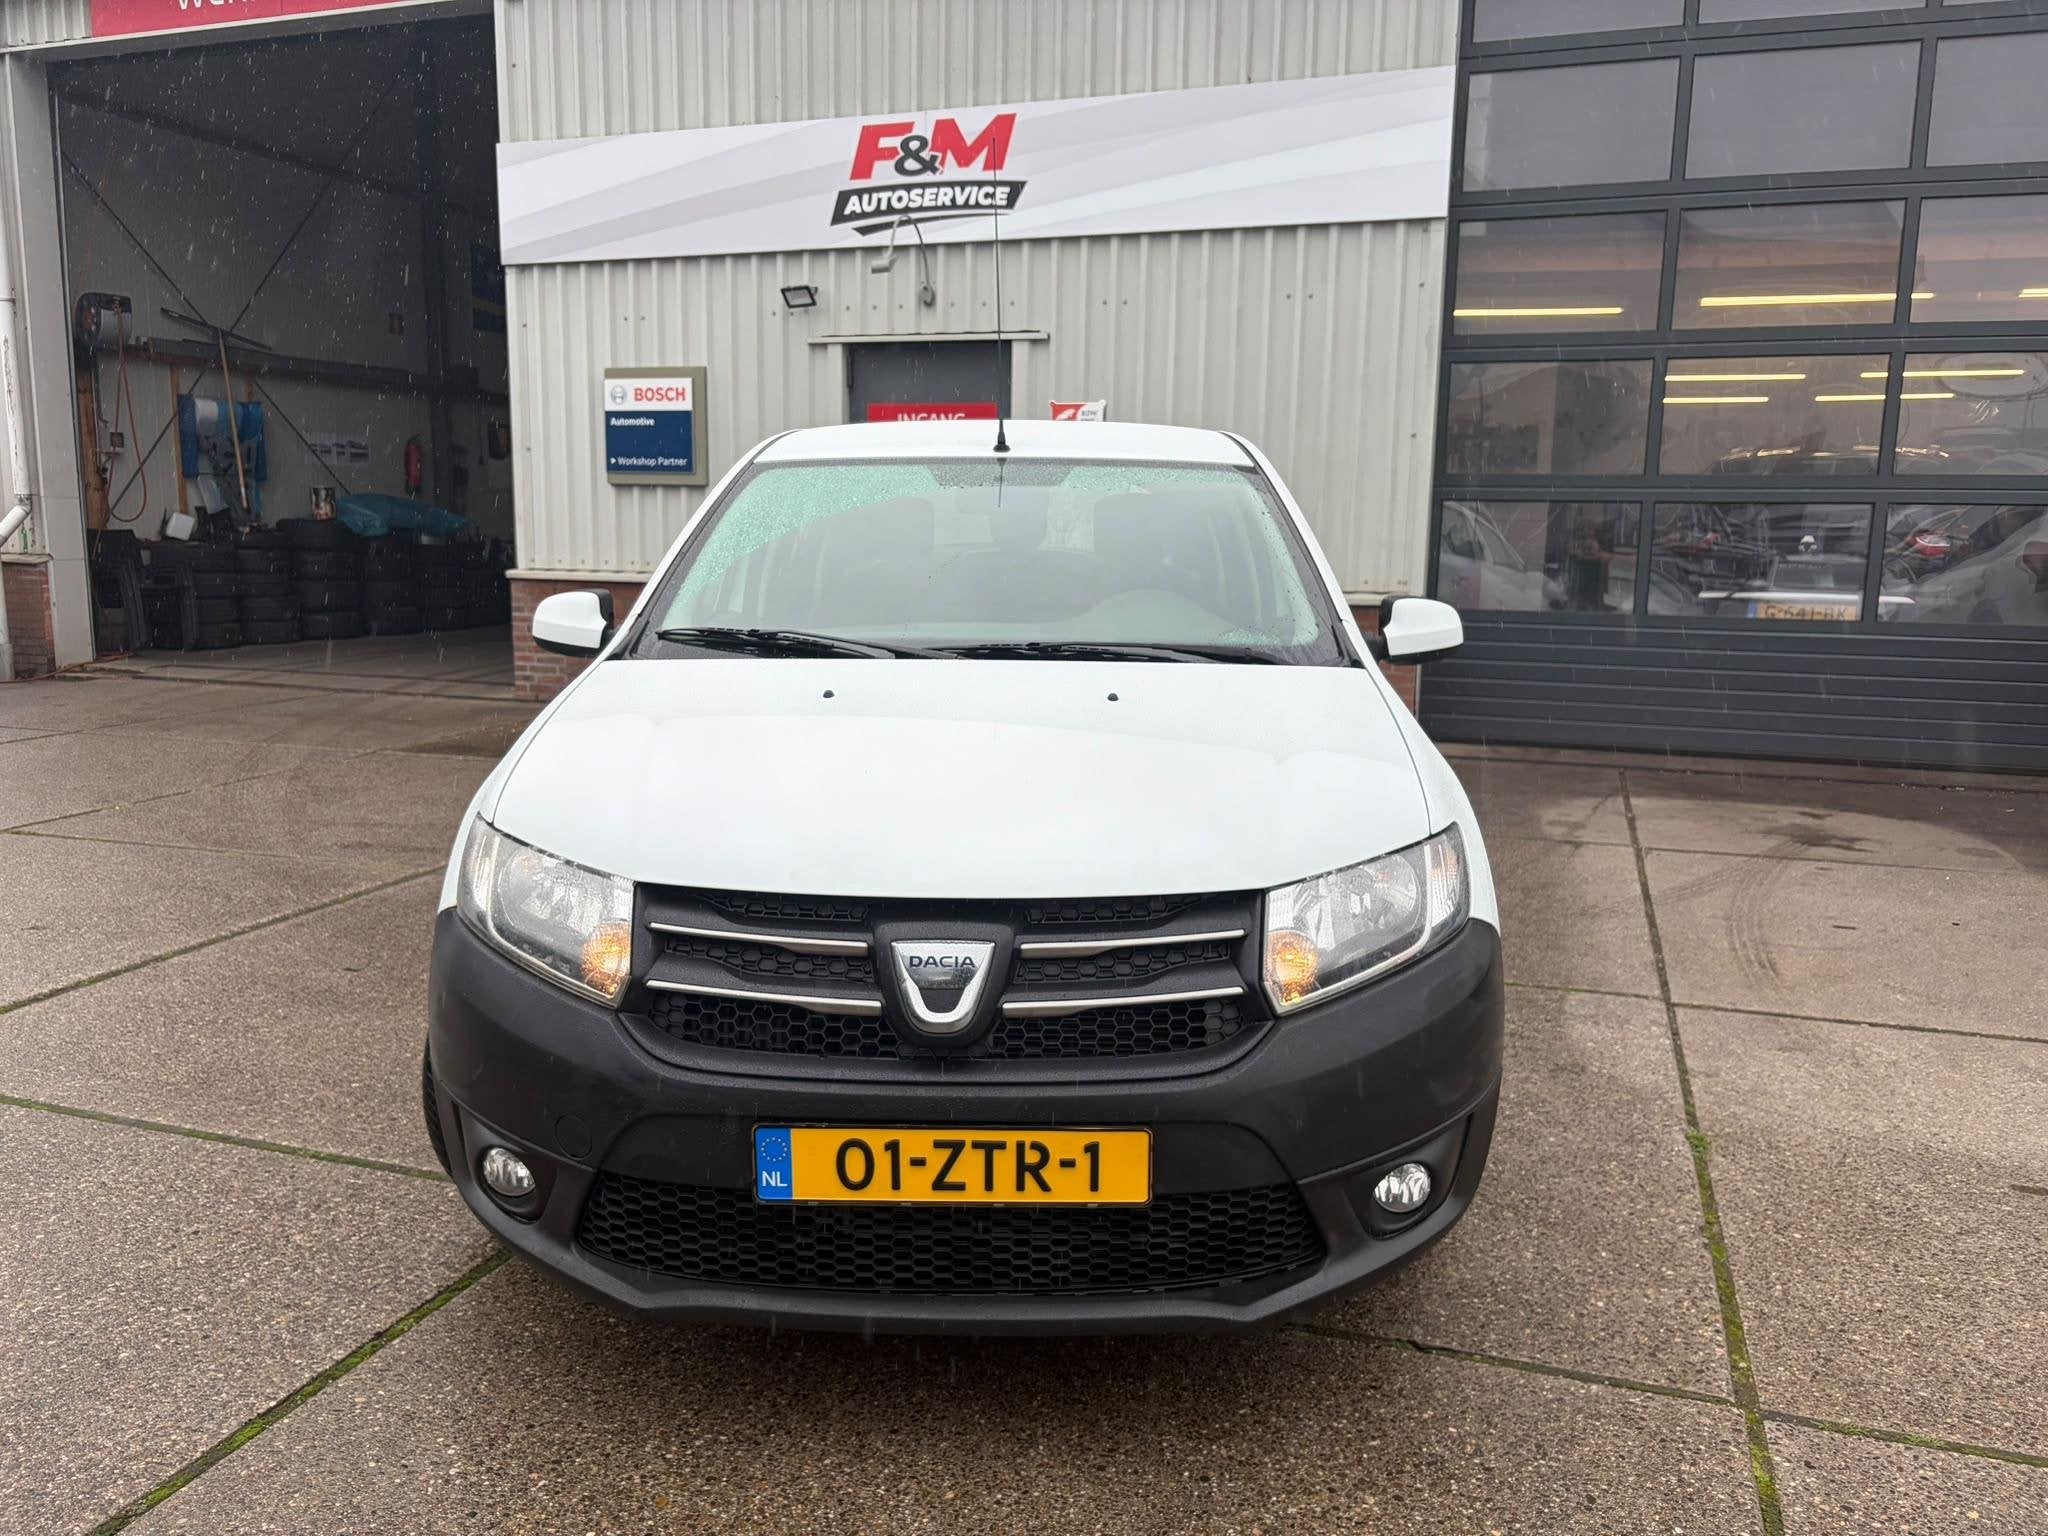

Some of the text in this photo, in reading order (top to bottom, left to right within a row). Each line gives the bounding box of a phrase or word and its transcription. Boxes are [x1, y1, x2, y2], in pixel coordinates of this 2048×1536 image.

[849, 113, 1017, 180] F&M
[843, 185, 1011, 216] AUTOSERVICE
[633, 387, 686, 402] BOSCH
[610, 417, 655, 427] Automotive
[617, 456, 688, 468] Workshop Partner
[908, 955, 976, 969] DACIA
[835, 1137, 1101, 1193] 01-ZTR-1
[761, 1170, 788, 1188] NL
